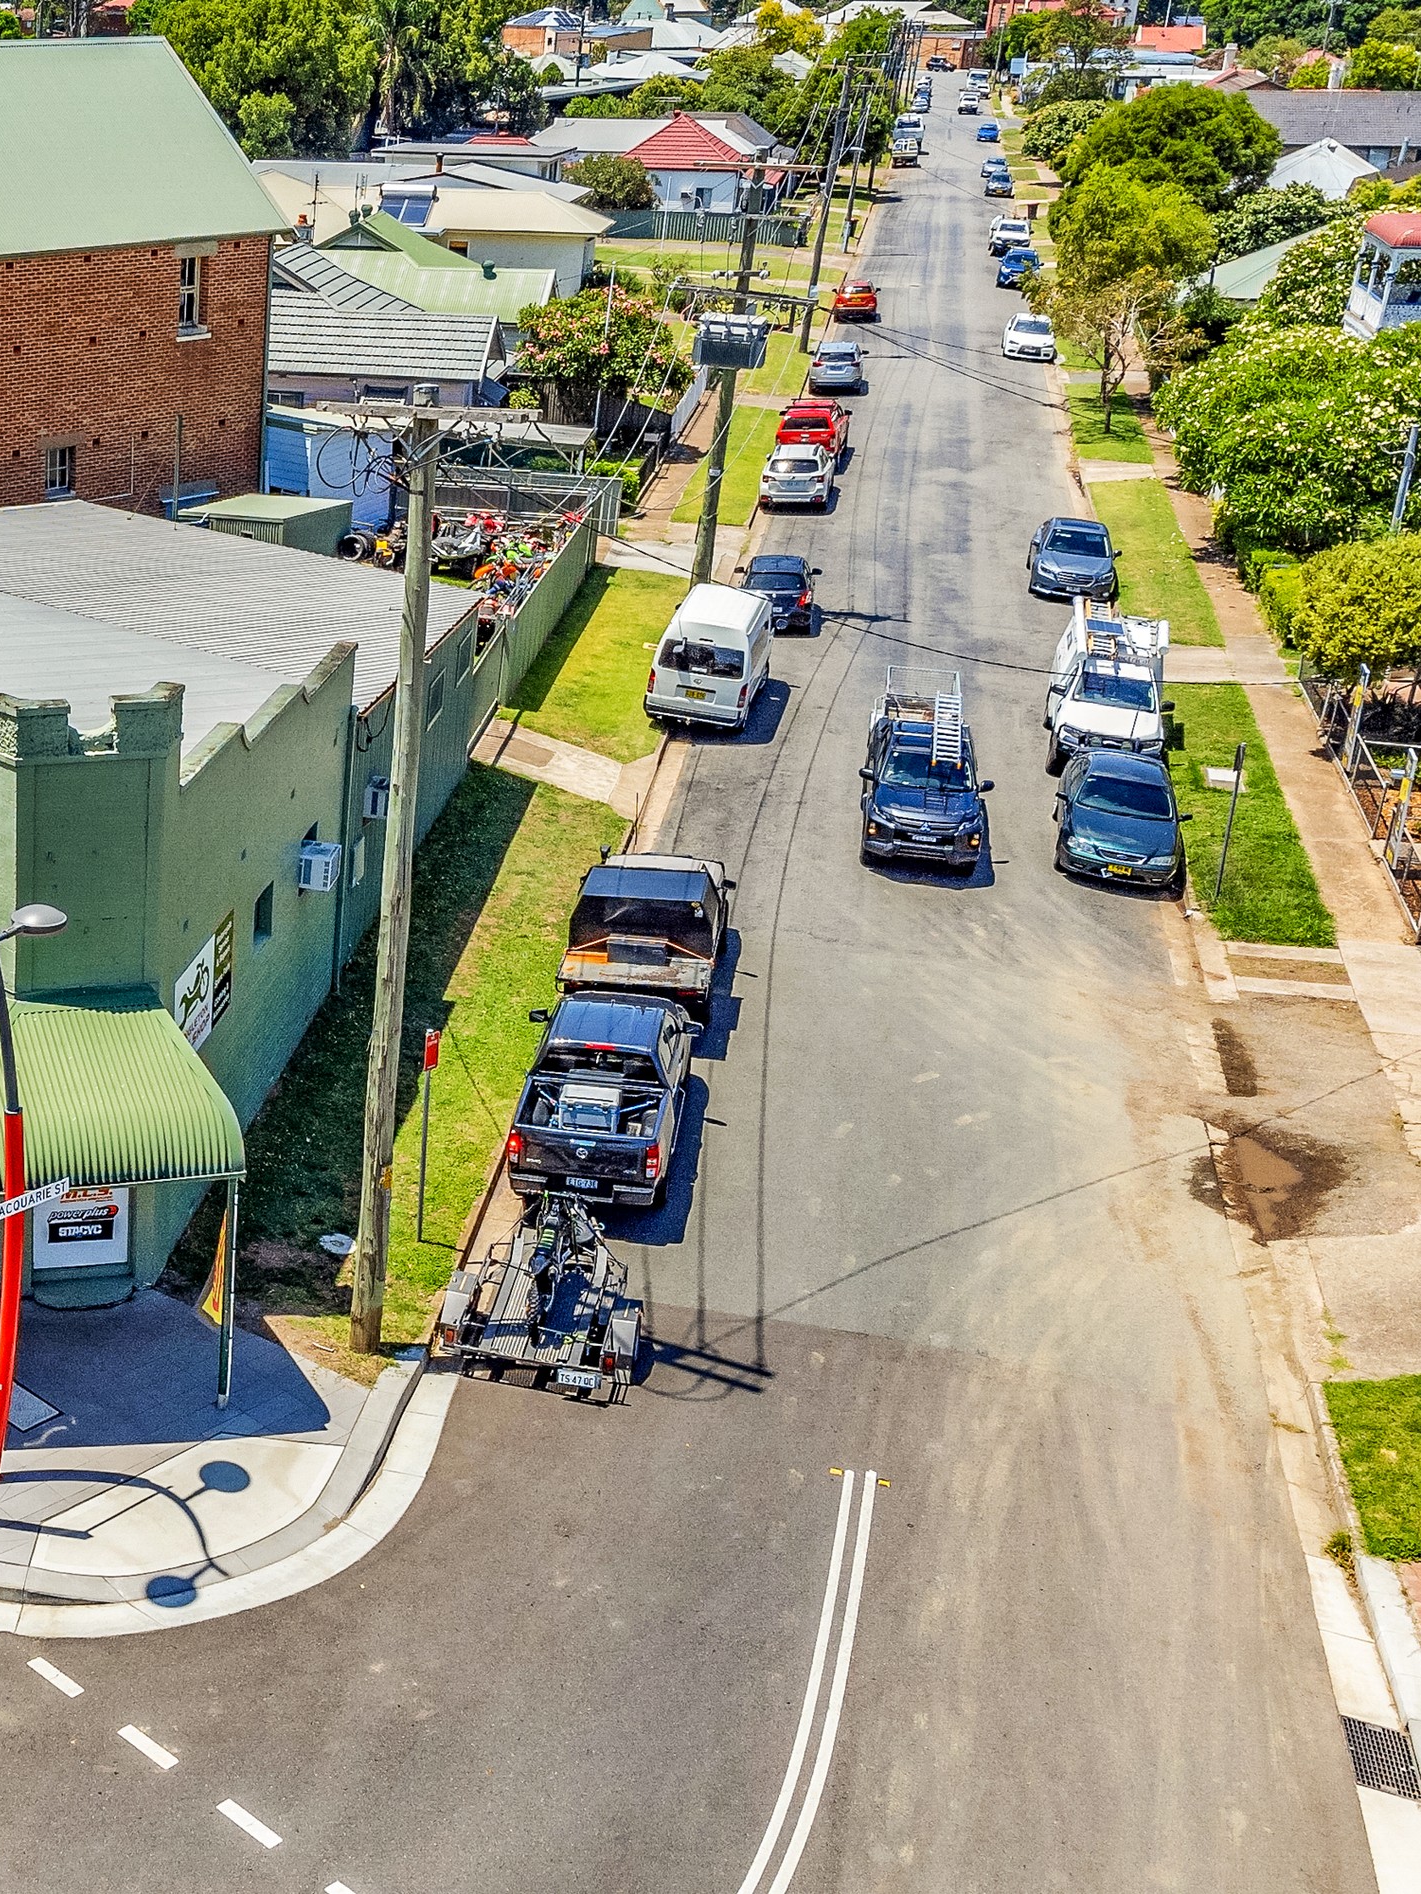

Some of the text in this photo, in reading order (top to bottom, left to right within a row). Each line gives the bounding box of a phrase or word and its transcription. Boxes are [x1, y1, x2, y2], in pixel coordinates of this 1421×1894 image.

[54, 1181, 66, 1195] ST
[48, 1205, 110, 1221] powerplus
[58, 1224, 103, 1237] STACYC
